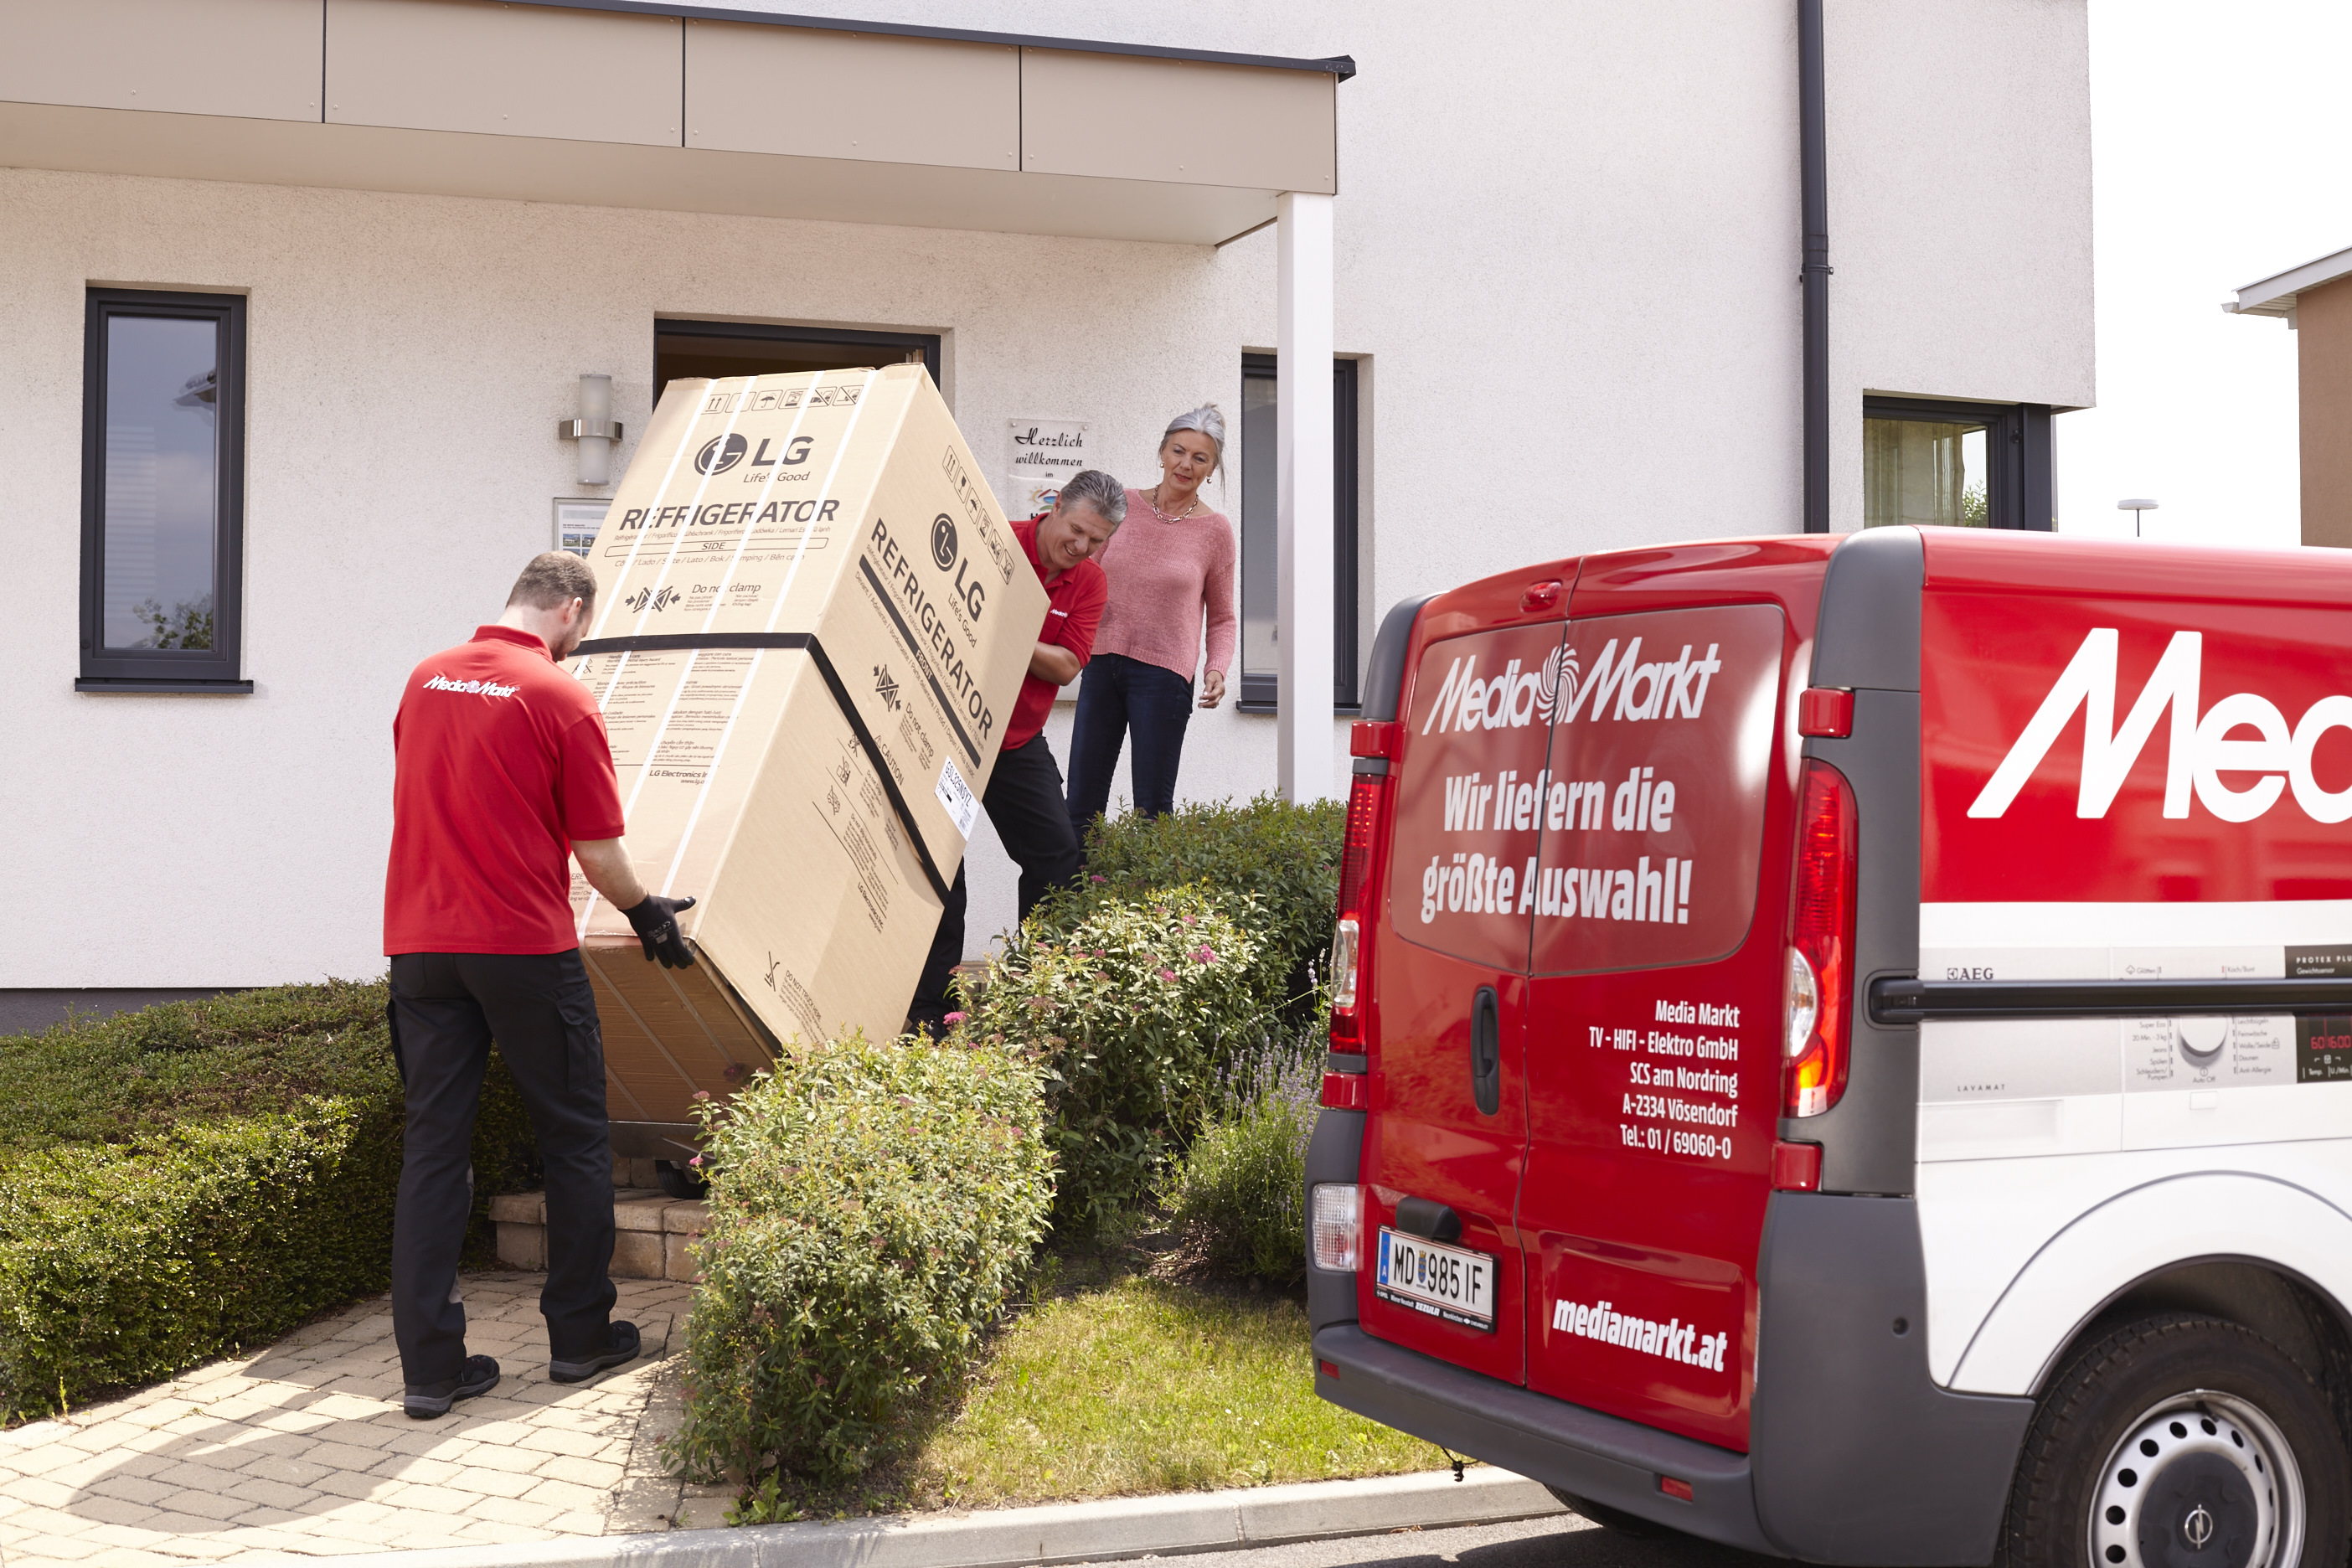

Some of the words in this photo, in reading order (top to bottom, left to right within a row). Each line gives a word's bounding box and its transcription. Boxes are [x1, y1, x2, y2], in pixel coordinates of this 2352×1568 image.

[751, 436, 815, 467] LG
[1014, 427, 1083, 447] Herzlich
[1015, 452, 1082, 467] willkommen
[777, 472, 811, 482] Good
[702, 542, 725, 550] SIDE
[692, 585, 707, 593] Do
[730, 583, 761, 594] clamp
[955, 557, 985, 622] LG
[871, 517, 993, 741] REFRIGERATOR
[947, 593, 963, 622] Life's
[962, 619, 977, 648] Good
[916, 648, 934, 680] FRONT
[423, 675, 467, 693] Media
[475, 681, 516, 698] Markt
[1421, 654, 1541, 735] Media
[1563, 637, 1721, 724] Markt
[905, 702, 913, 719] Do
[661, 770, 701, 778] Electronics
[881, 744, 905, 786] CAUTION
[1444, 771, 1493, 832] Wir
[1493, 769, 1607, 832] liefern
[1612, 766, 1676, 833] die
[1421, 853, 1515, 924] größte
[1517, 856, 1693, 925] Auswahl!
[785, 970, 793, 981] DO
[1959, 967, 1994, 980] AEG
[1655, 1000, 1695, 1024] Media
[1698, 1003, 1740, 1028] Markt
[1589, 1026, 1603, 1048] TV
[1613, 1029, 1637, 1051] HIFI
[1648, 1031, 1694, 1057] Elektro
[1697, 1035, 1738, 1061] GmbH
[2310, 1036, 2325, 1050] 60
[1630, 1061, 1651, 1085] SCS
[1653, 1067, 1674, 1087] am
[1677, 1066, 1738, 1098] Nordring
[1622, 1093, 1665, 1118] A-2334
[1668, 1098, 1738, 1127] Vösendorf
[1620, 1124, 1645, 1148] Tel.:
[1647, 1127, 1662, 1150] 01
[1674, 1131, 1731, 1159] 69060-0
[1382, 1265, 1387, 1277] A
[1394, 1243, 1415, 1285] MD
[1428, 1253, 1460, 1299] 985
[1466, 1262, 1483, 1304] IF
[1415, 1301, 1440, 1317] ZEZULA
[1552, 1299, 1727, 1372] mediamarkt.at
